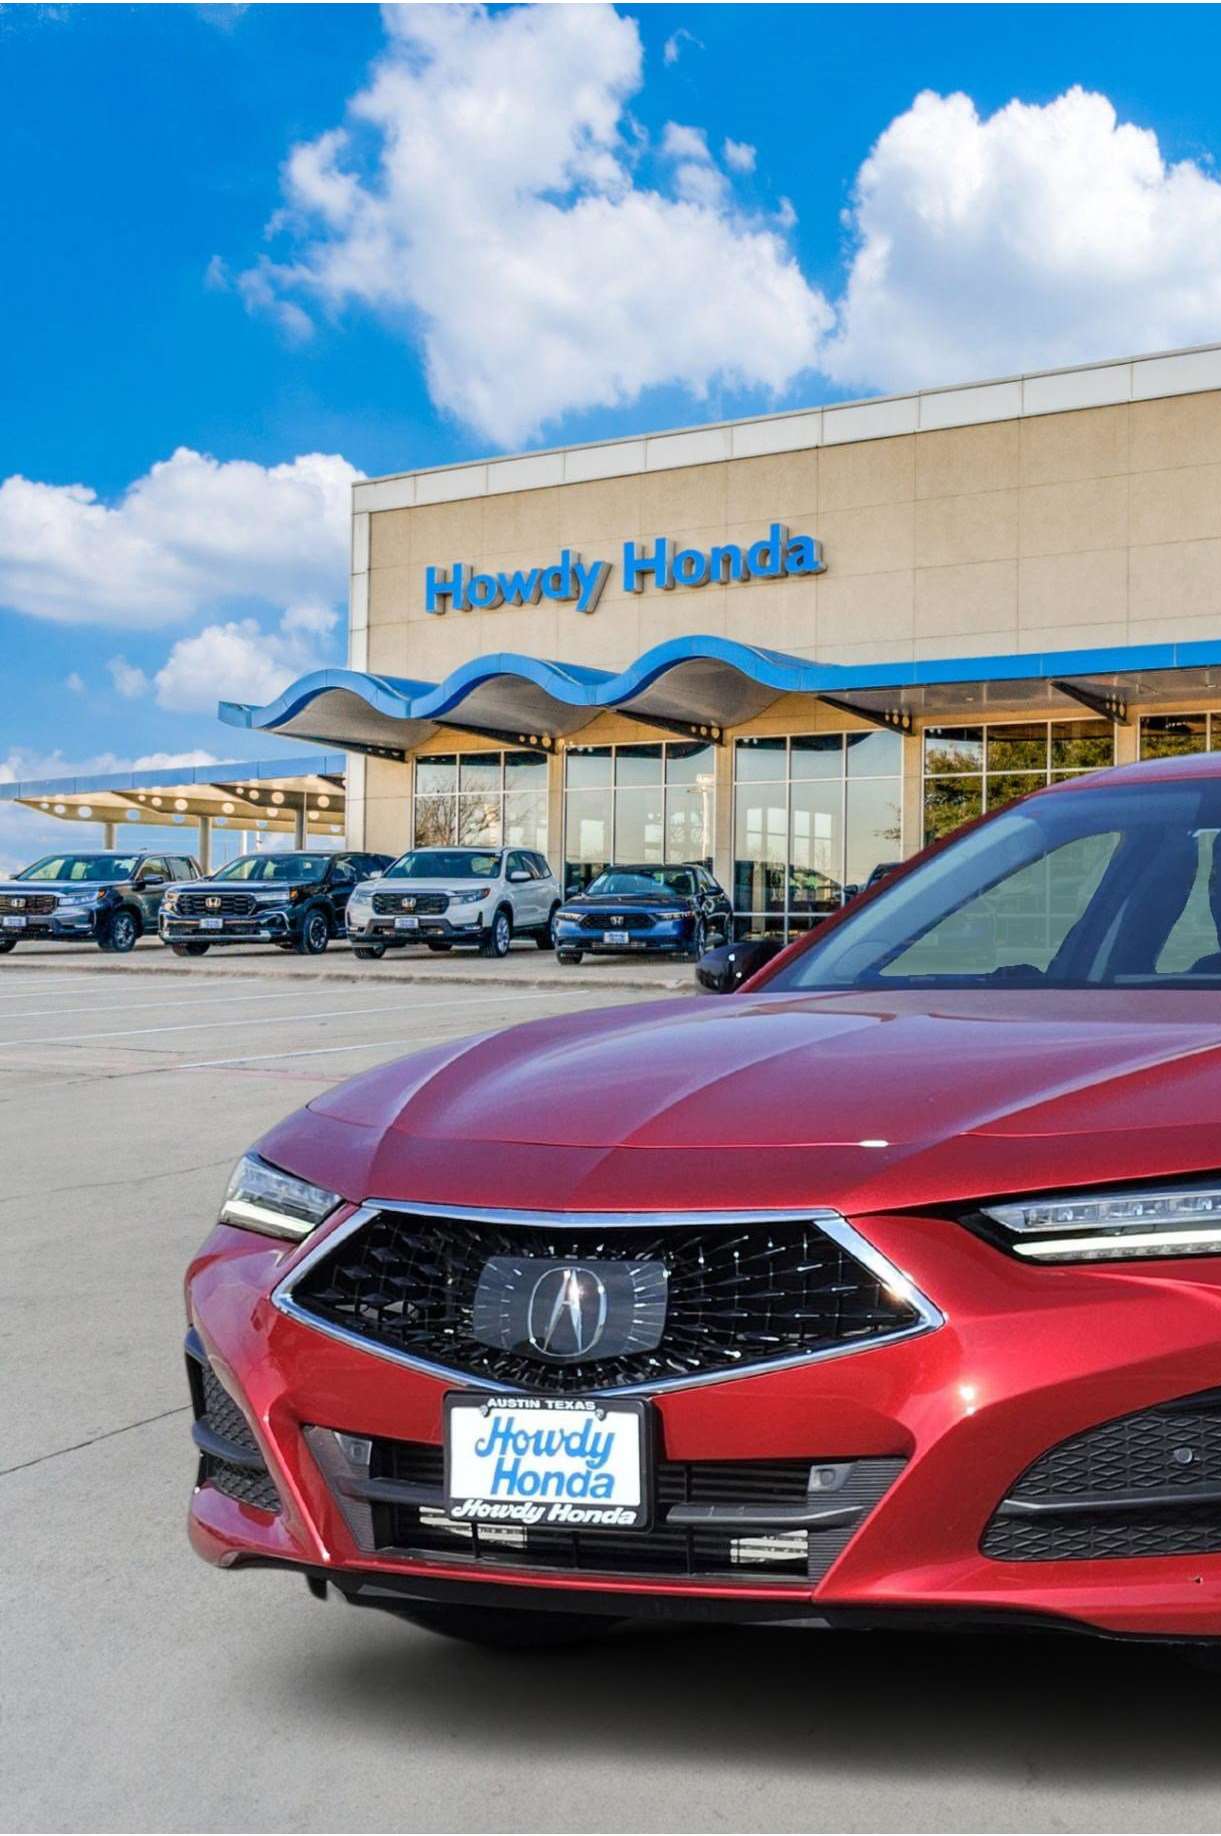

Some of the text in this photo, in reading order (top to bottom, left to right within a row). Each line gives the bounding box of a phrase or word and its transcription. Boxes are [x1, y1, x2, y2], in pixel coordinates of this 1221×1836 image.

[425, 523, 828, 615] Howdy Honda
[487, 1398, 596, 1411] AUSTIN TEXAS
[475, 1416, 616, 1469] Howdy
[490, 1457, 616, 1498] Honda
[451, 1499, 637, 1524] Howdy Honda
